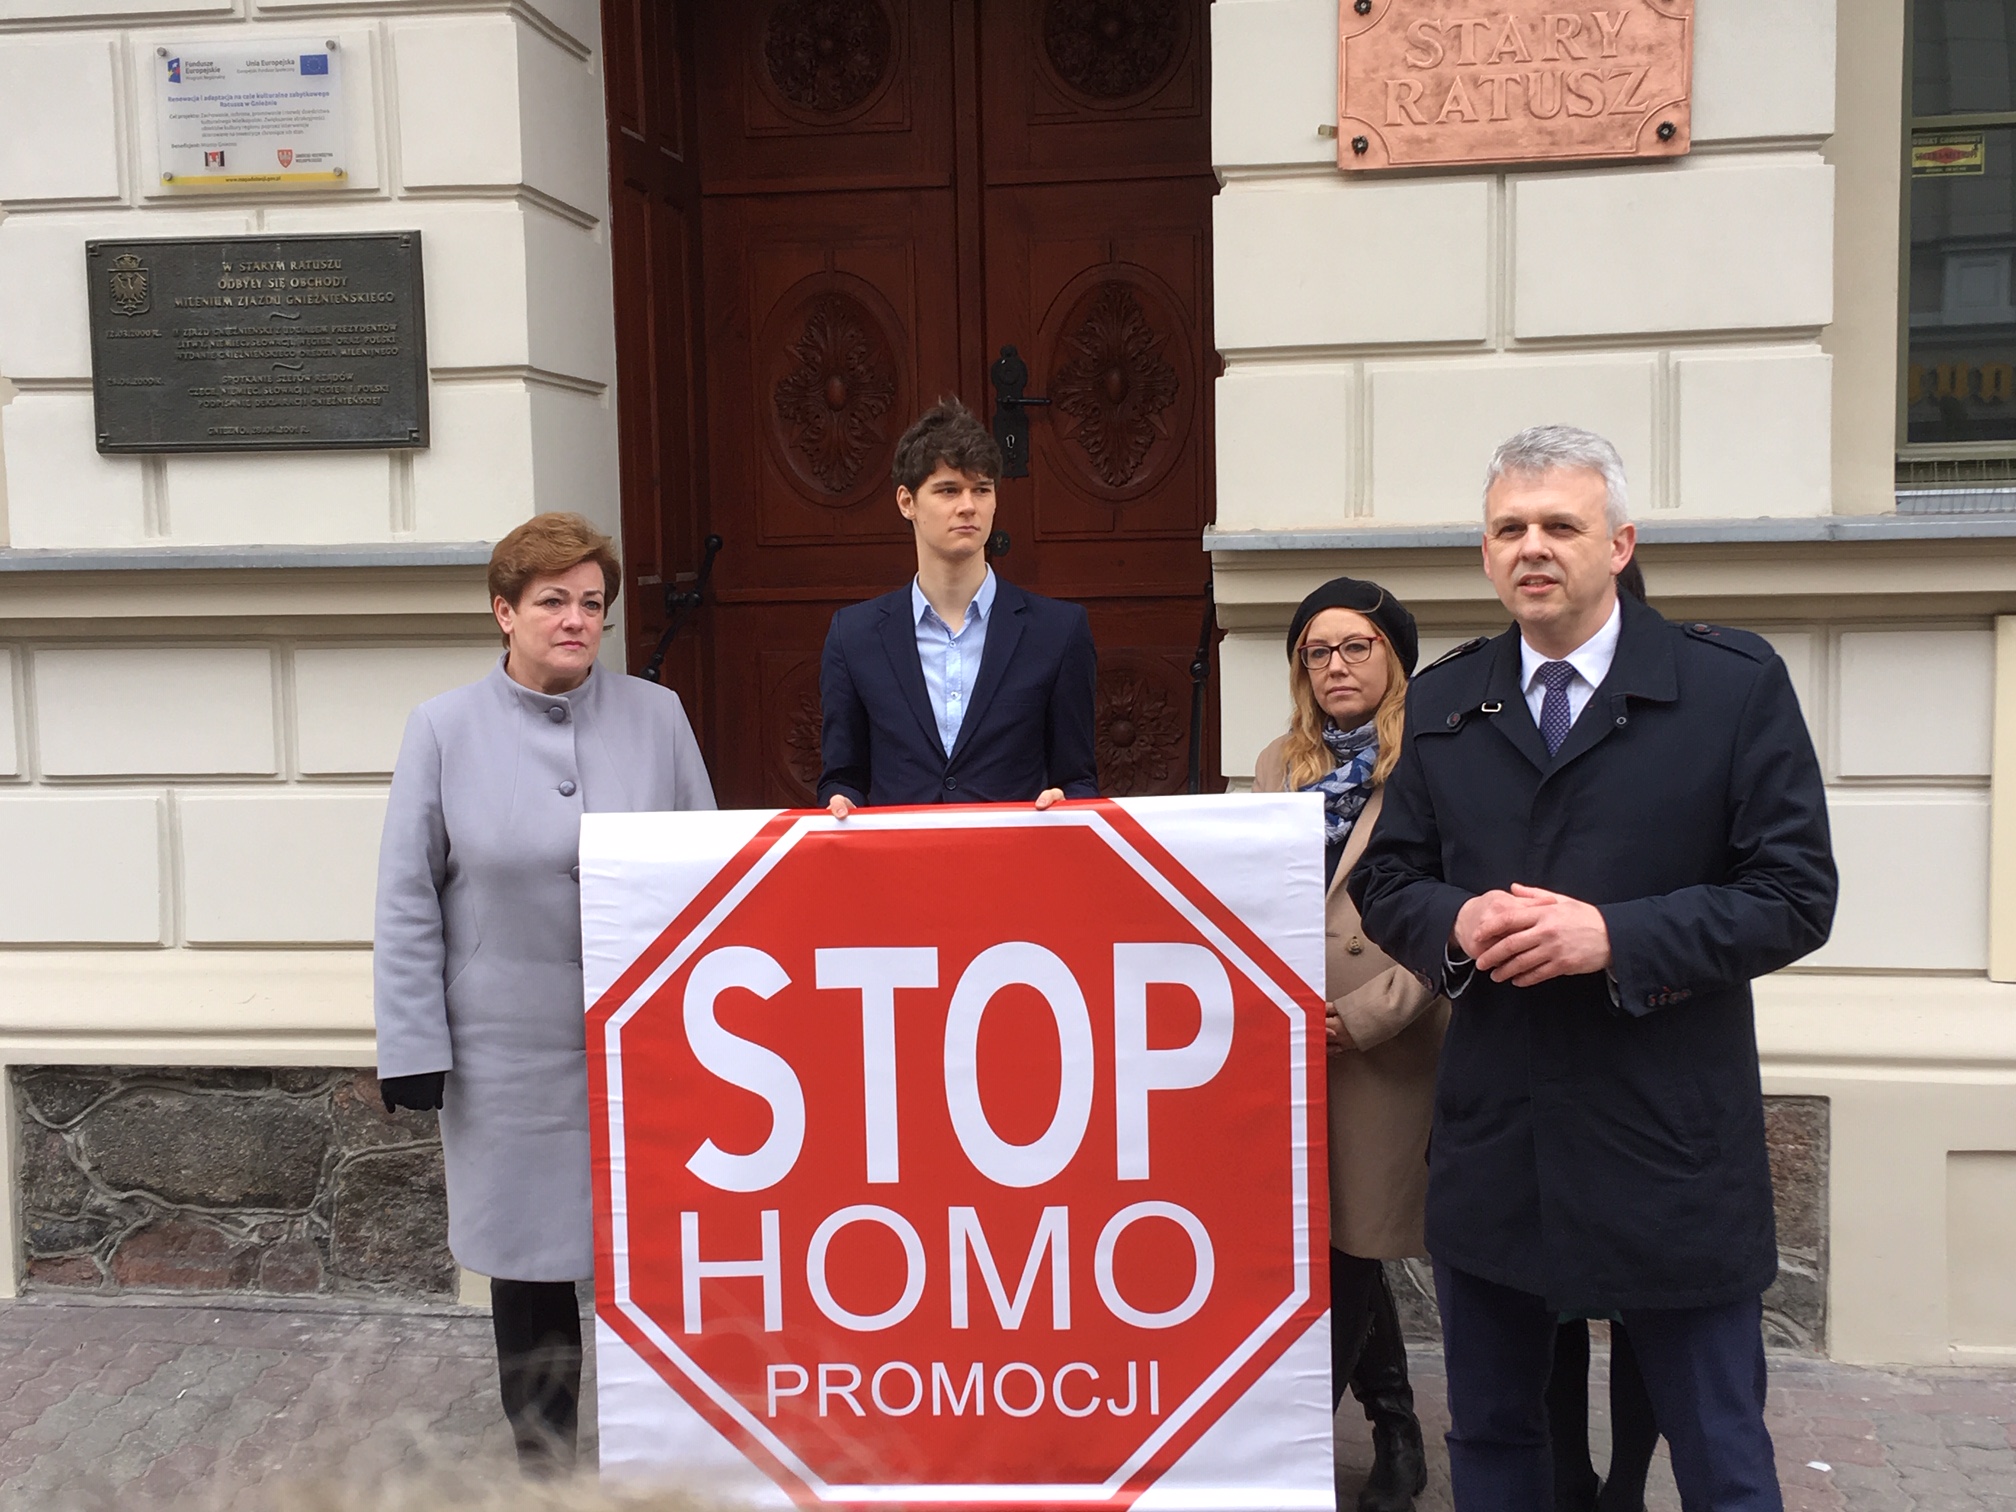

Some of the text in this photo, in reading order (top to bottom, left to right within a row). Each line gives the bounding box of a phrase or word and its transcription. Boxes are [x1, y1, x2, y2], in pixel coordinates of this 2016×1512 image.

[1404, 10, 1630, 69] STARY
[185, 67, 221, 75] Europejskie
[204, 94, 233, 102] adaptacja
[289, 90, 330, 98] zabytkowego
[1384, 66, 1651, 127] RATUSZ
[222, 259, 343, 271] W STARYM RATUSZU
[218, 276, 348, 290] ODBYŁY SIĘ OBCHODY
[174, 296, 233, 308] MILENIUM
[238, 294, 281, 308] ZJAZDU
[363, 335, 396, 345] POLSKI
[683, 941, 1235, 1193] STOP
[680, 1200, 1215, 1334] HOMO
[766, 1360, 1160, 1418] PROMOCJI
